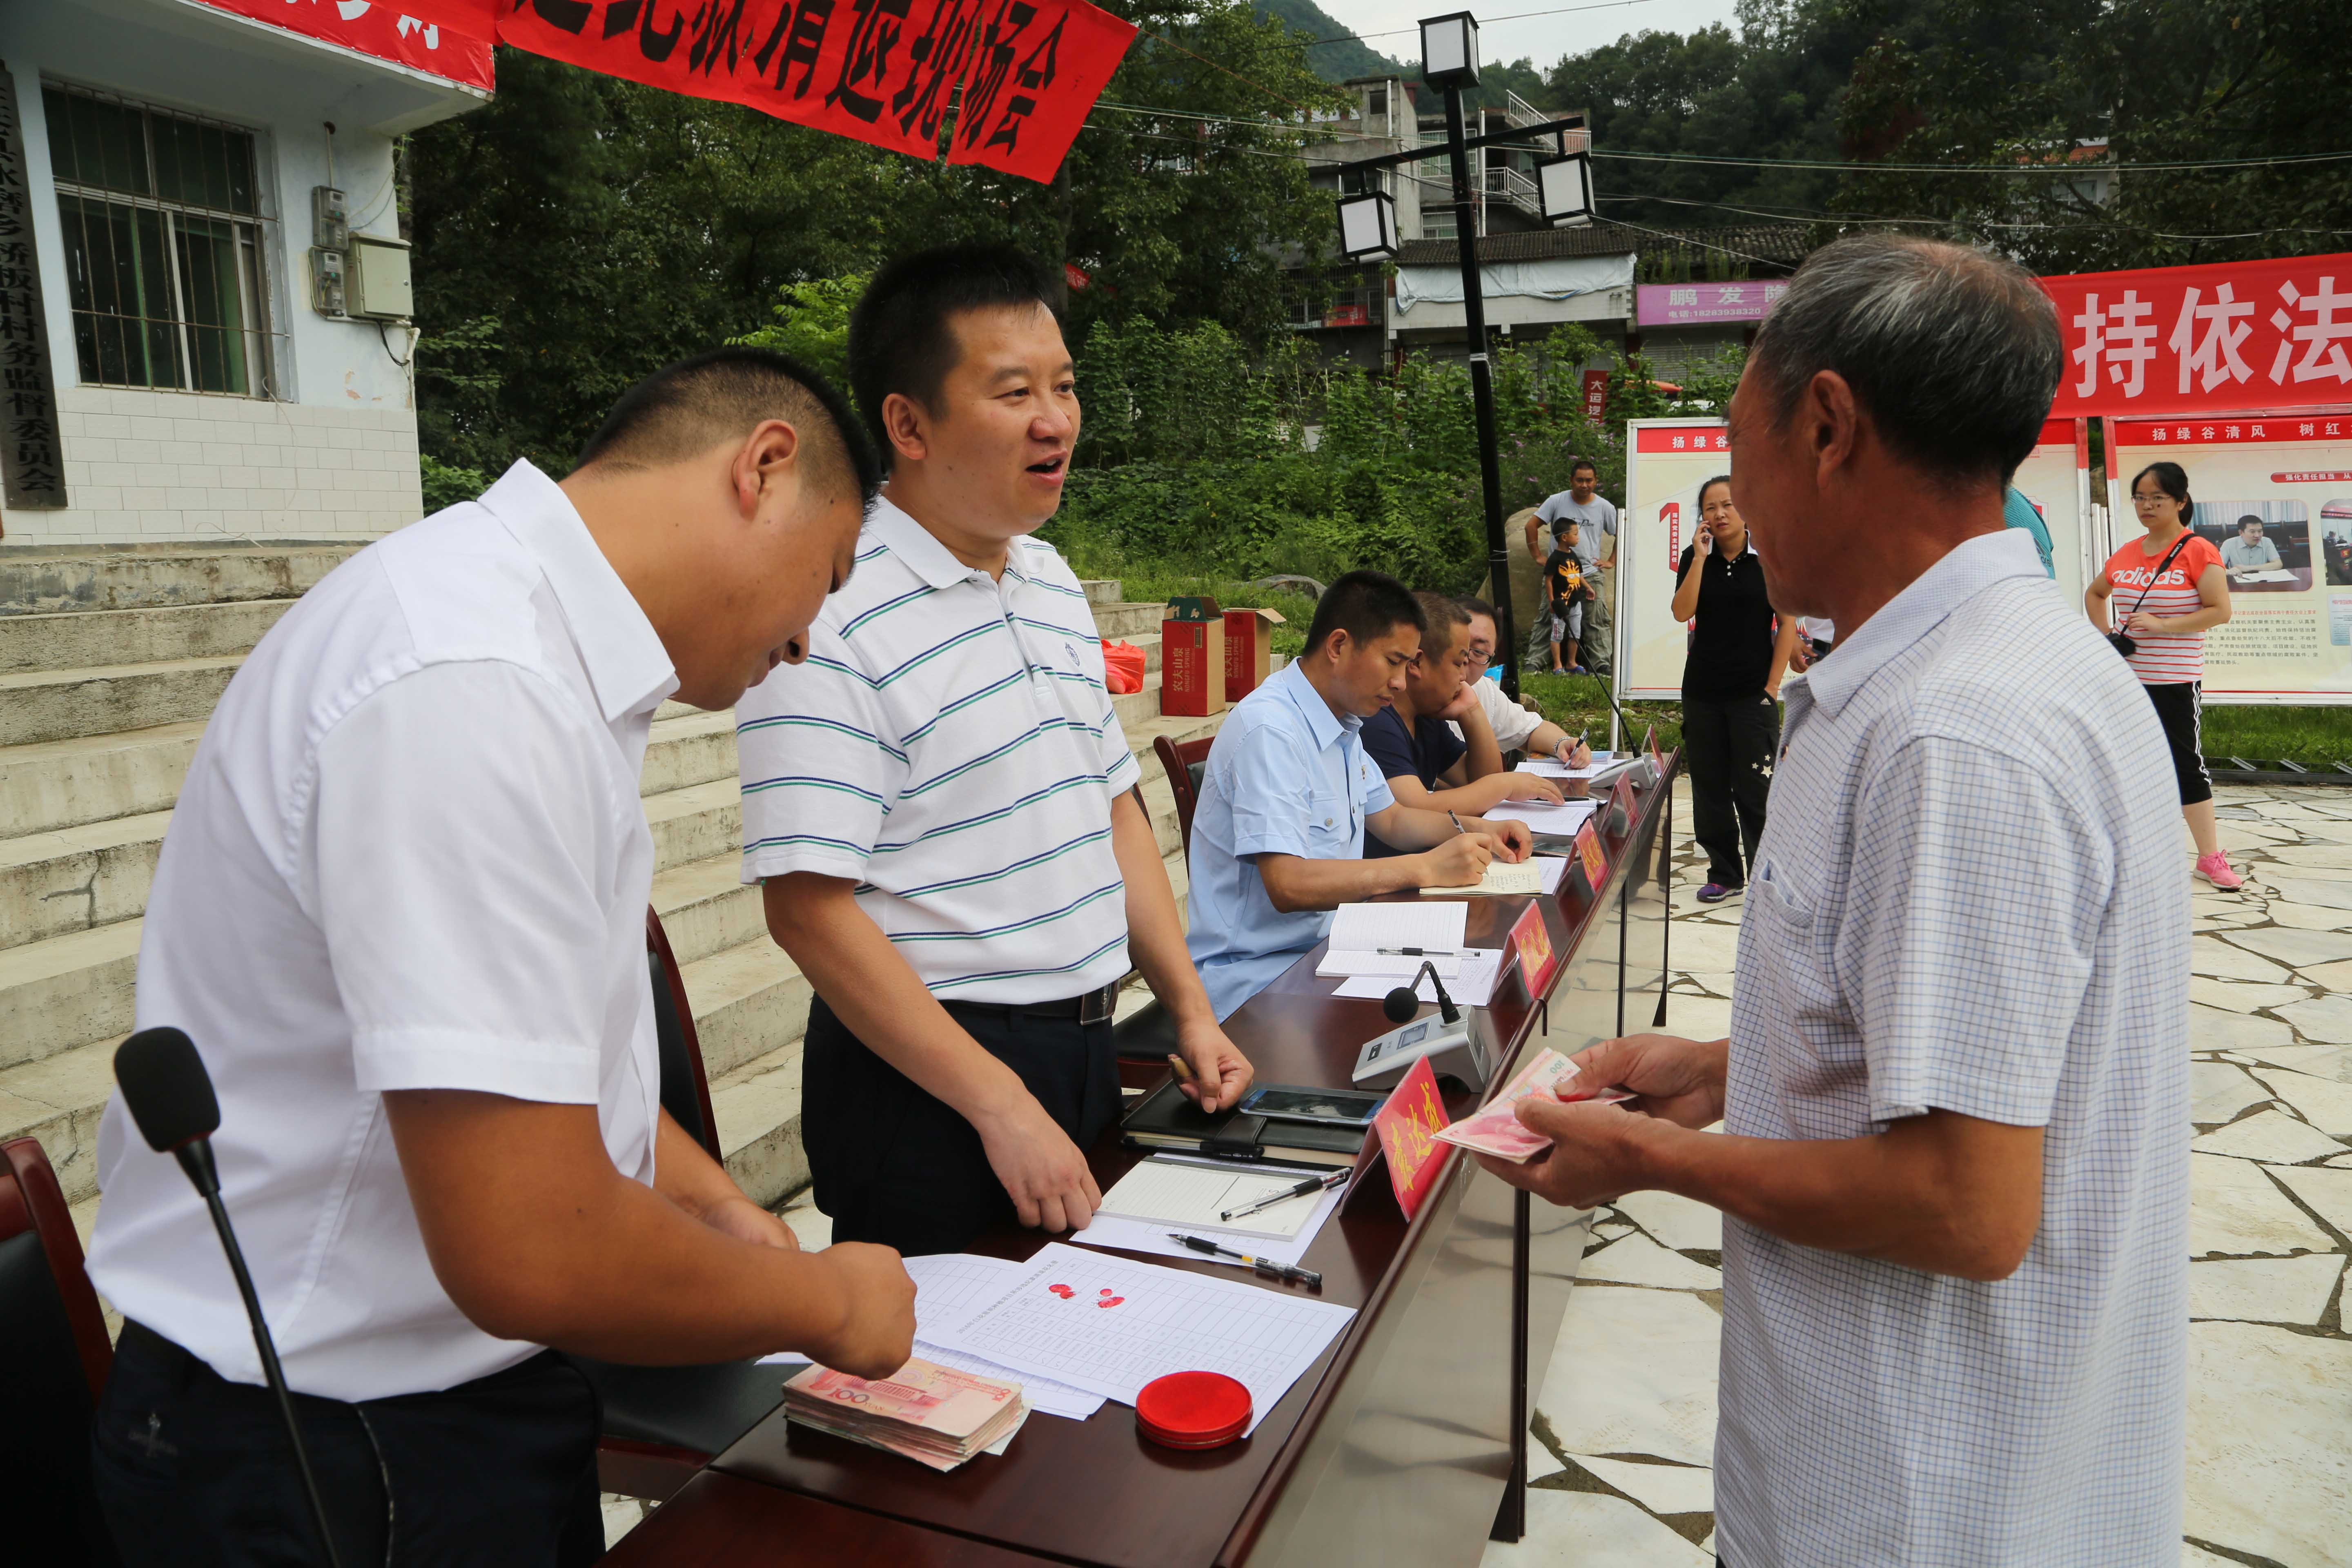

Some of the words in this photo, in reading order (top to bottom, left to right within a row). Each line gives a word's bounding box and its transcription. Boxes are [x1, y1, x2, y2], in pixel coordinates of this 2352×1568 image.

[2053, 276, 2352, 398] 持依法
[2152, 425, 2266, 441] 扬绿谷清风
[2299, 422, 2352, 437] 树红
[2169, 543, 2183, 557] Canon
[2112, 566, 2185, 587] adidas
[1172, 647, 1184, 692] 农夫山泉
[1550, 1059, 1565, 1074] 100
[826, 1388, 871, 1404] 100
[864, 1400, 885, 1411] YUAN
